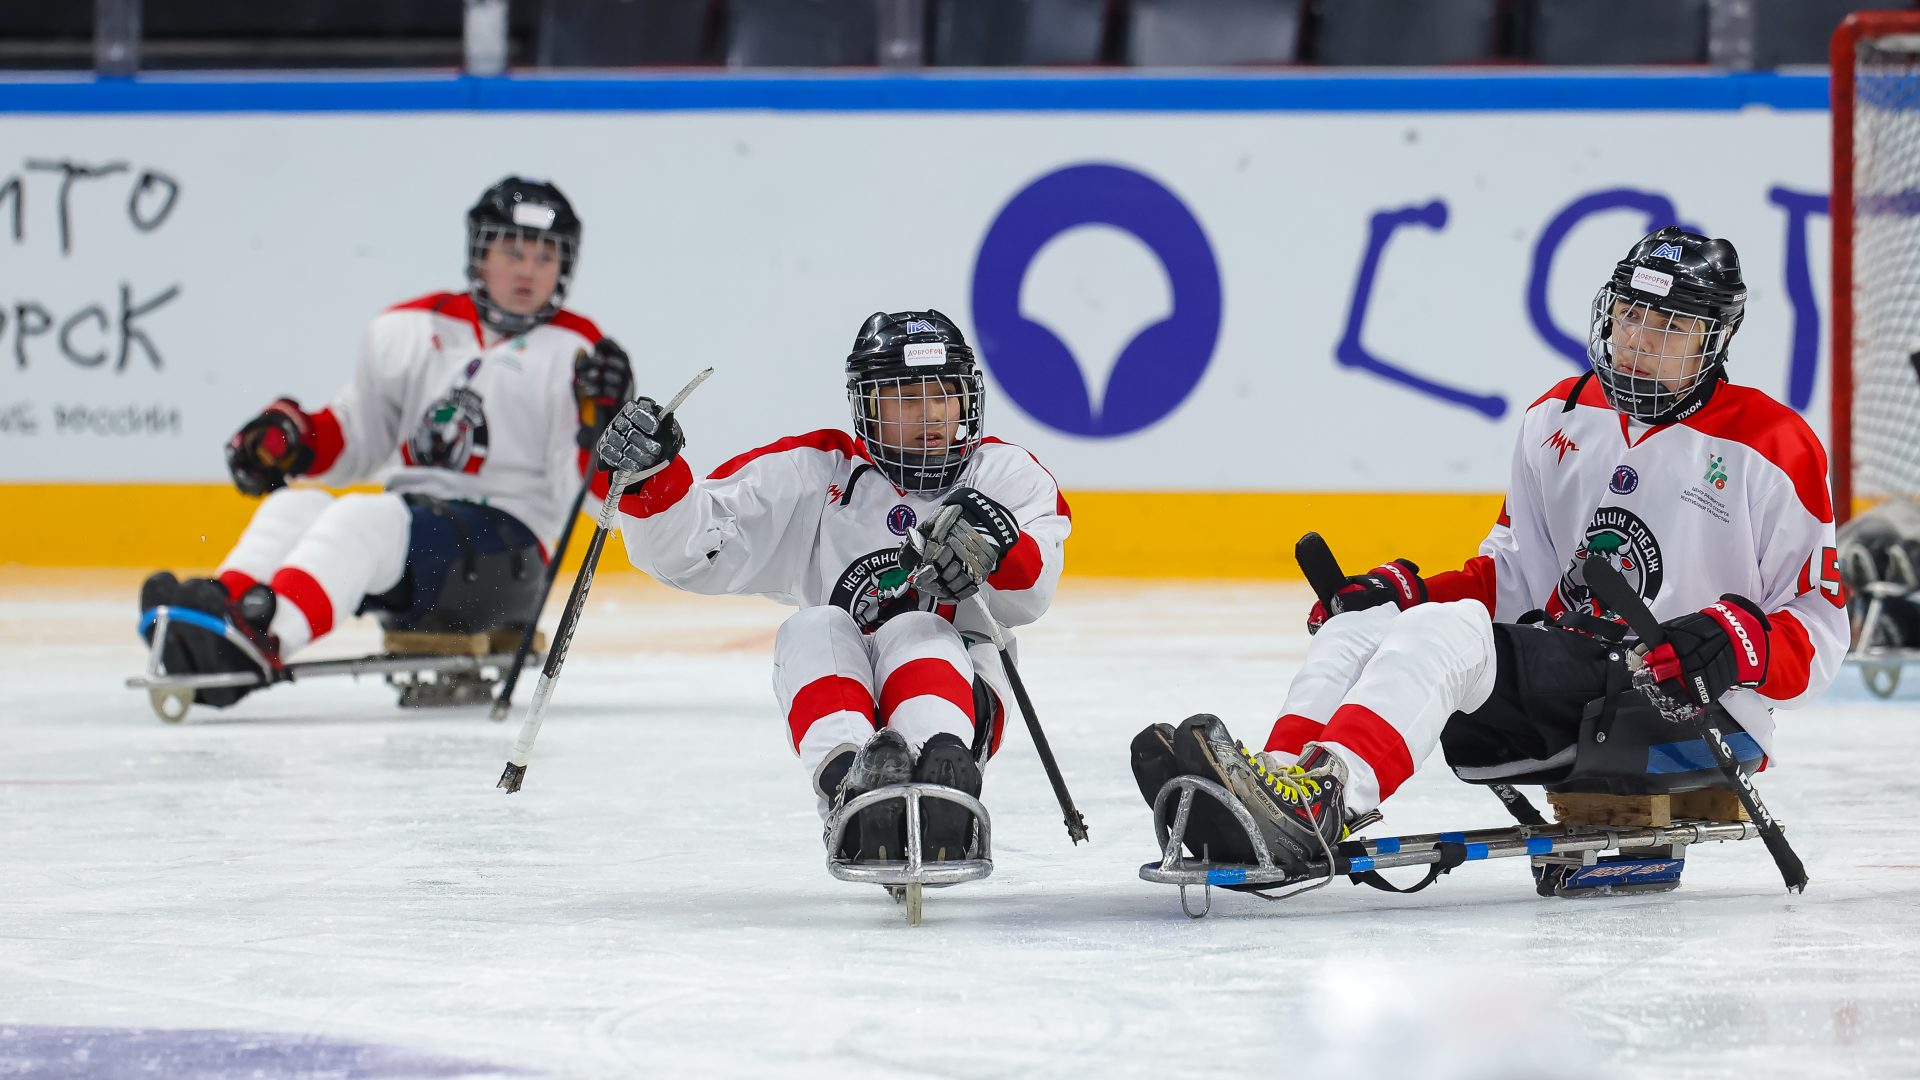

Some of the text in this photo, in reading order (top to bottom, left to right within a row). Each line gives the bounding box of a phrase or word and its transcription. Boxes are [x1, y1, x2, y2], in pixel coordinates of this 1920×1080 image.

[0, 279, 182, 376] РСК
[1675, 399, 1702, 421] TIXON
[1628, 520, 1659, 573] СЛЕДЖ
[1711, 603, 1759, 667] R-WOOD
[1693, 676, 1710, 704] REKKER
